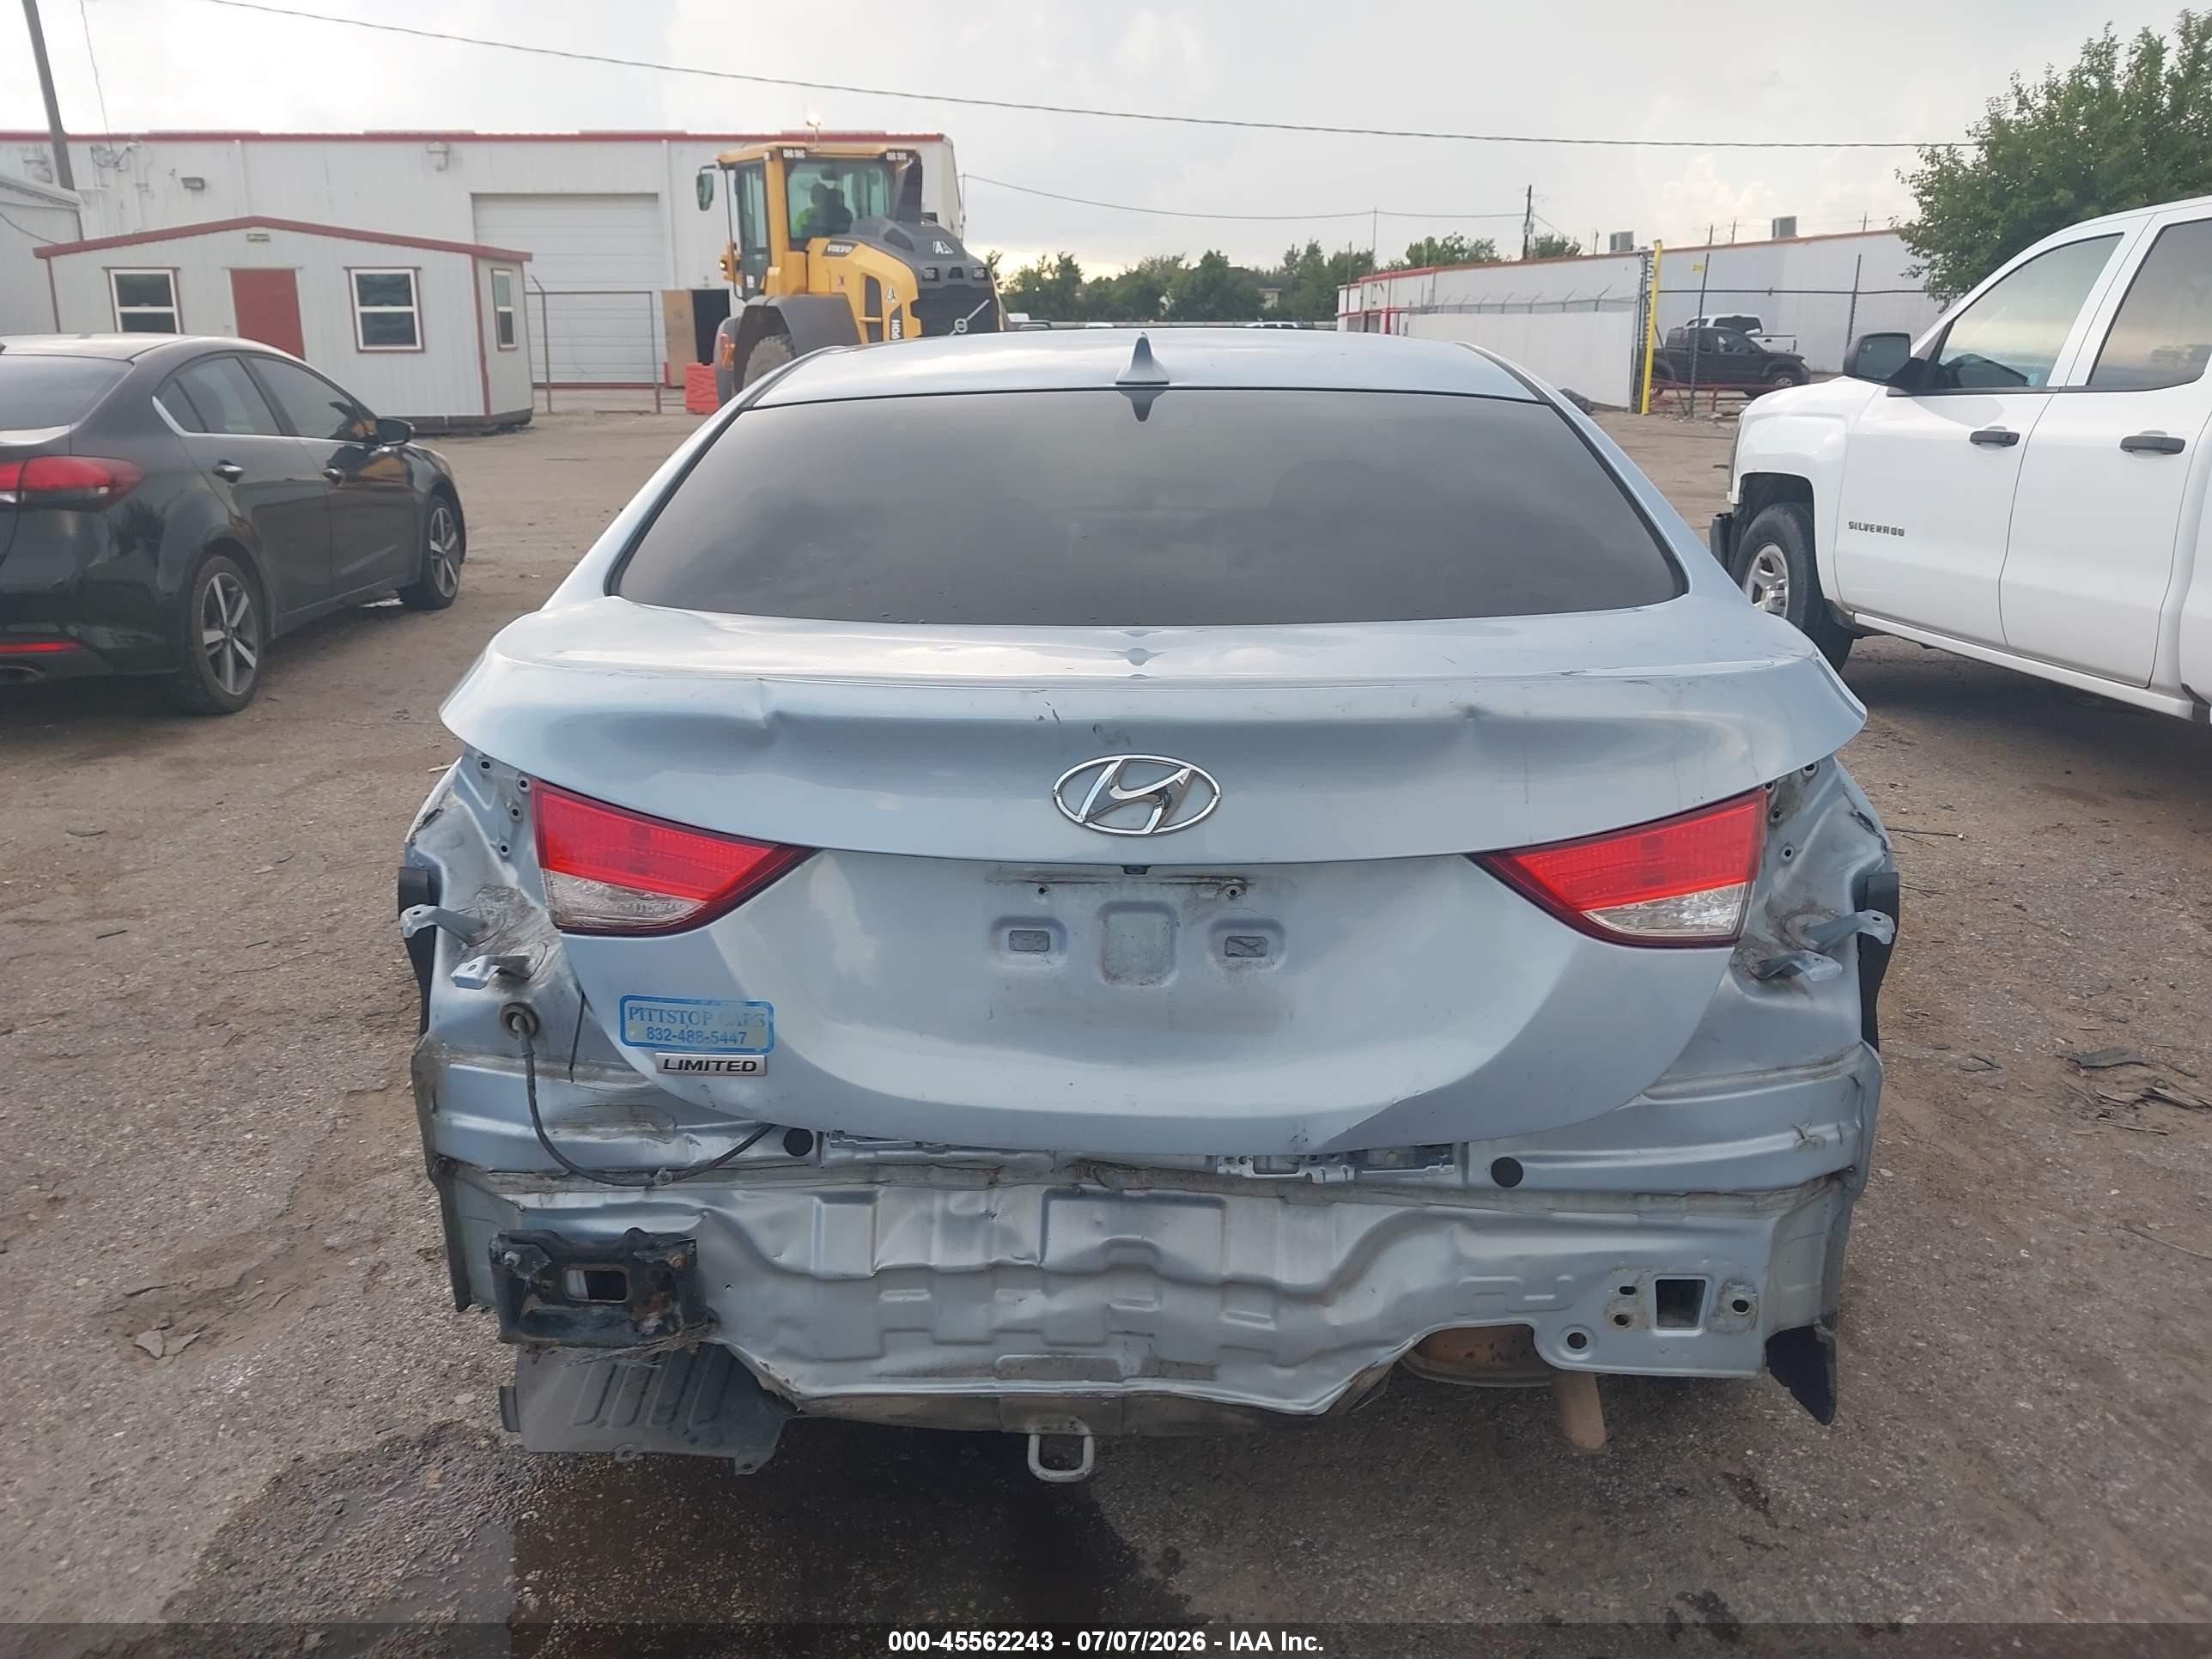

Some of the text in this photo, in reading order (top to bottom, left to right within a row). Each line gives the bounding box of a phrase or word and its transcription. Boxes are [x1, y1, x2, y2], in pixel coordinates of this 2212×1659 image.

[1848, 521, 1905, 537] SILVERADO
[629, 1006, 713, 1027] PITTSTOP
[646, 1026, 748, 1045] 832-488-5447
[663, 1058, 757, 1073] LIMITED
